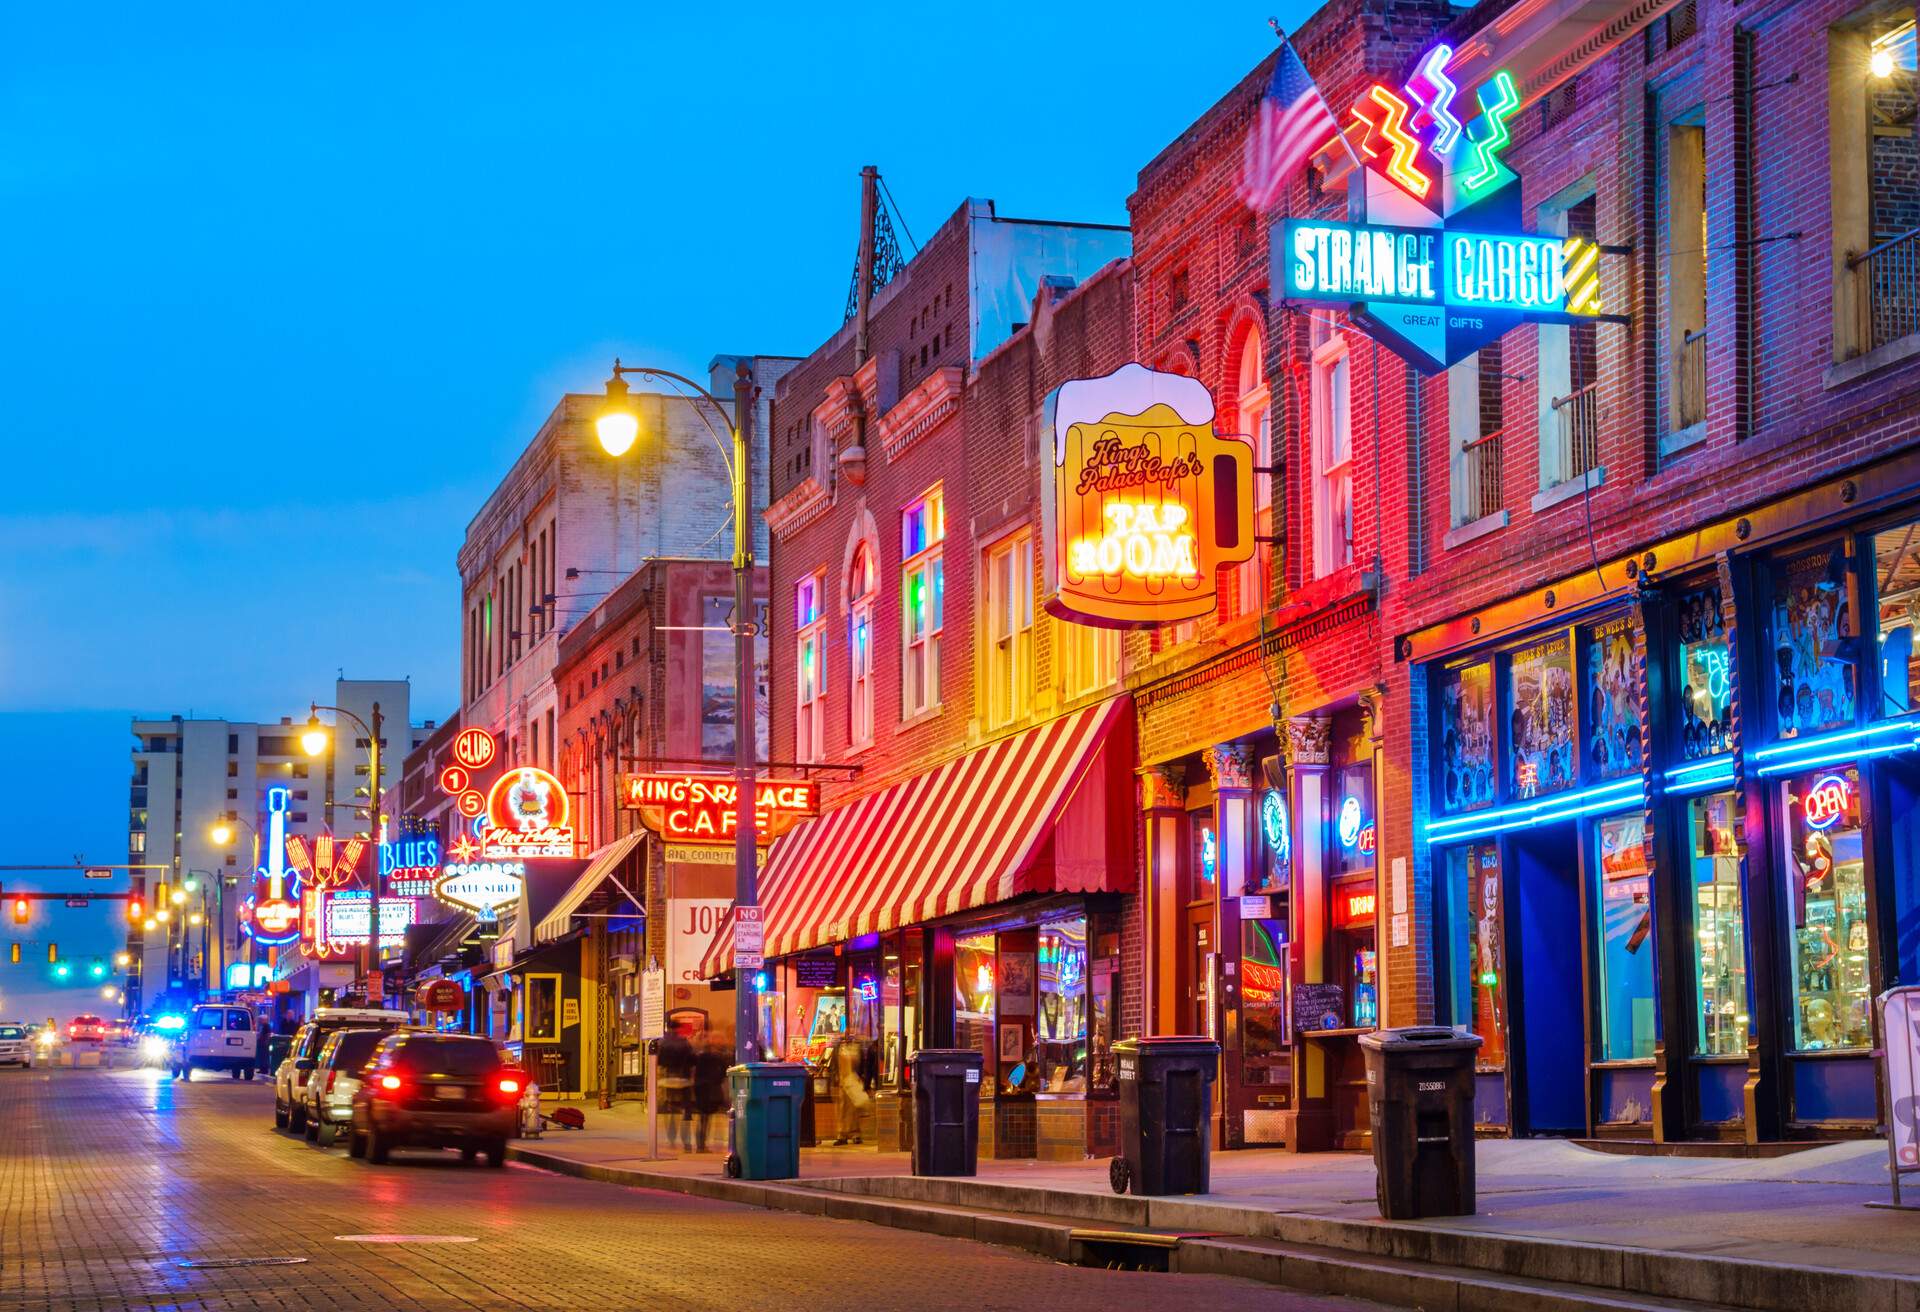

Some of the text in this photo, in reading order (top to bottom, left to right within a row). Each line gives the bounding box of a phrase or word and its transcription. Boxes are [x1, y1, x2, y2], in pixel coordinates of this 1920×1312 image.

[1294, 227, 1559, 305] STRANGE CARGO
[1402, 314, 1483, 329] GREAT GIFTS
[1087, 438, 1150, 470] Kings
[1076, 465, 1145, 496] Palace
[1105, 503, 1188, 536] TAP
[1072, 534, 1198, 574] ROOM
[459, 733, 491, 763] CLUB
[448, 772, 459, 789] 1
[631, 776, 705, 802] KING'S
[464, 795, 479, 812] 5
[1805, 783, 1847, 820] OPEN
[1359, 828, 1375, 850] OPE
[383, 841, 437, 876] BLUES
[391, 867, 437, 879] CITY
[397, 888, 430, 896] STORE
[682, 906, 730, 935] JOH
[740, 909, 758, 919] NO
